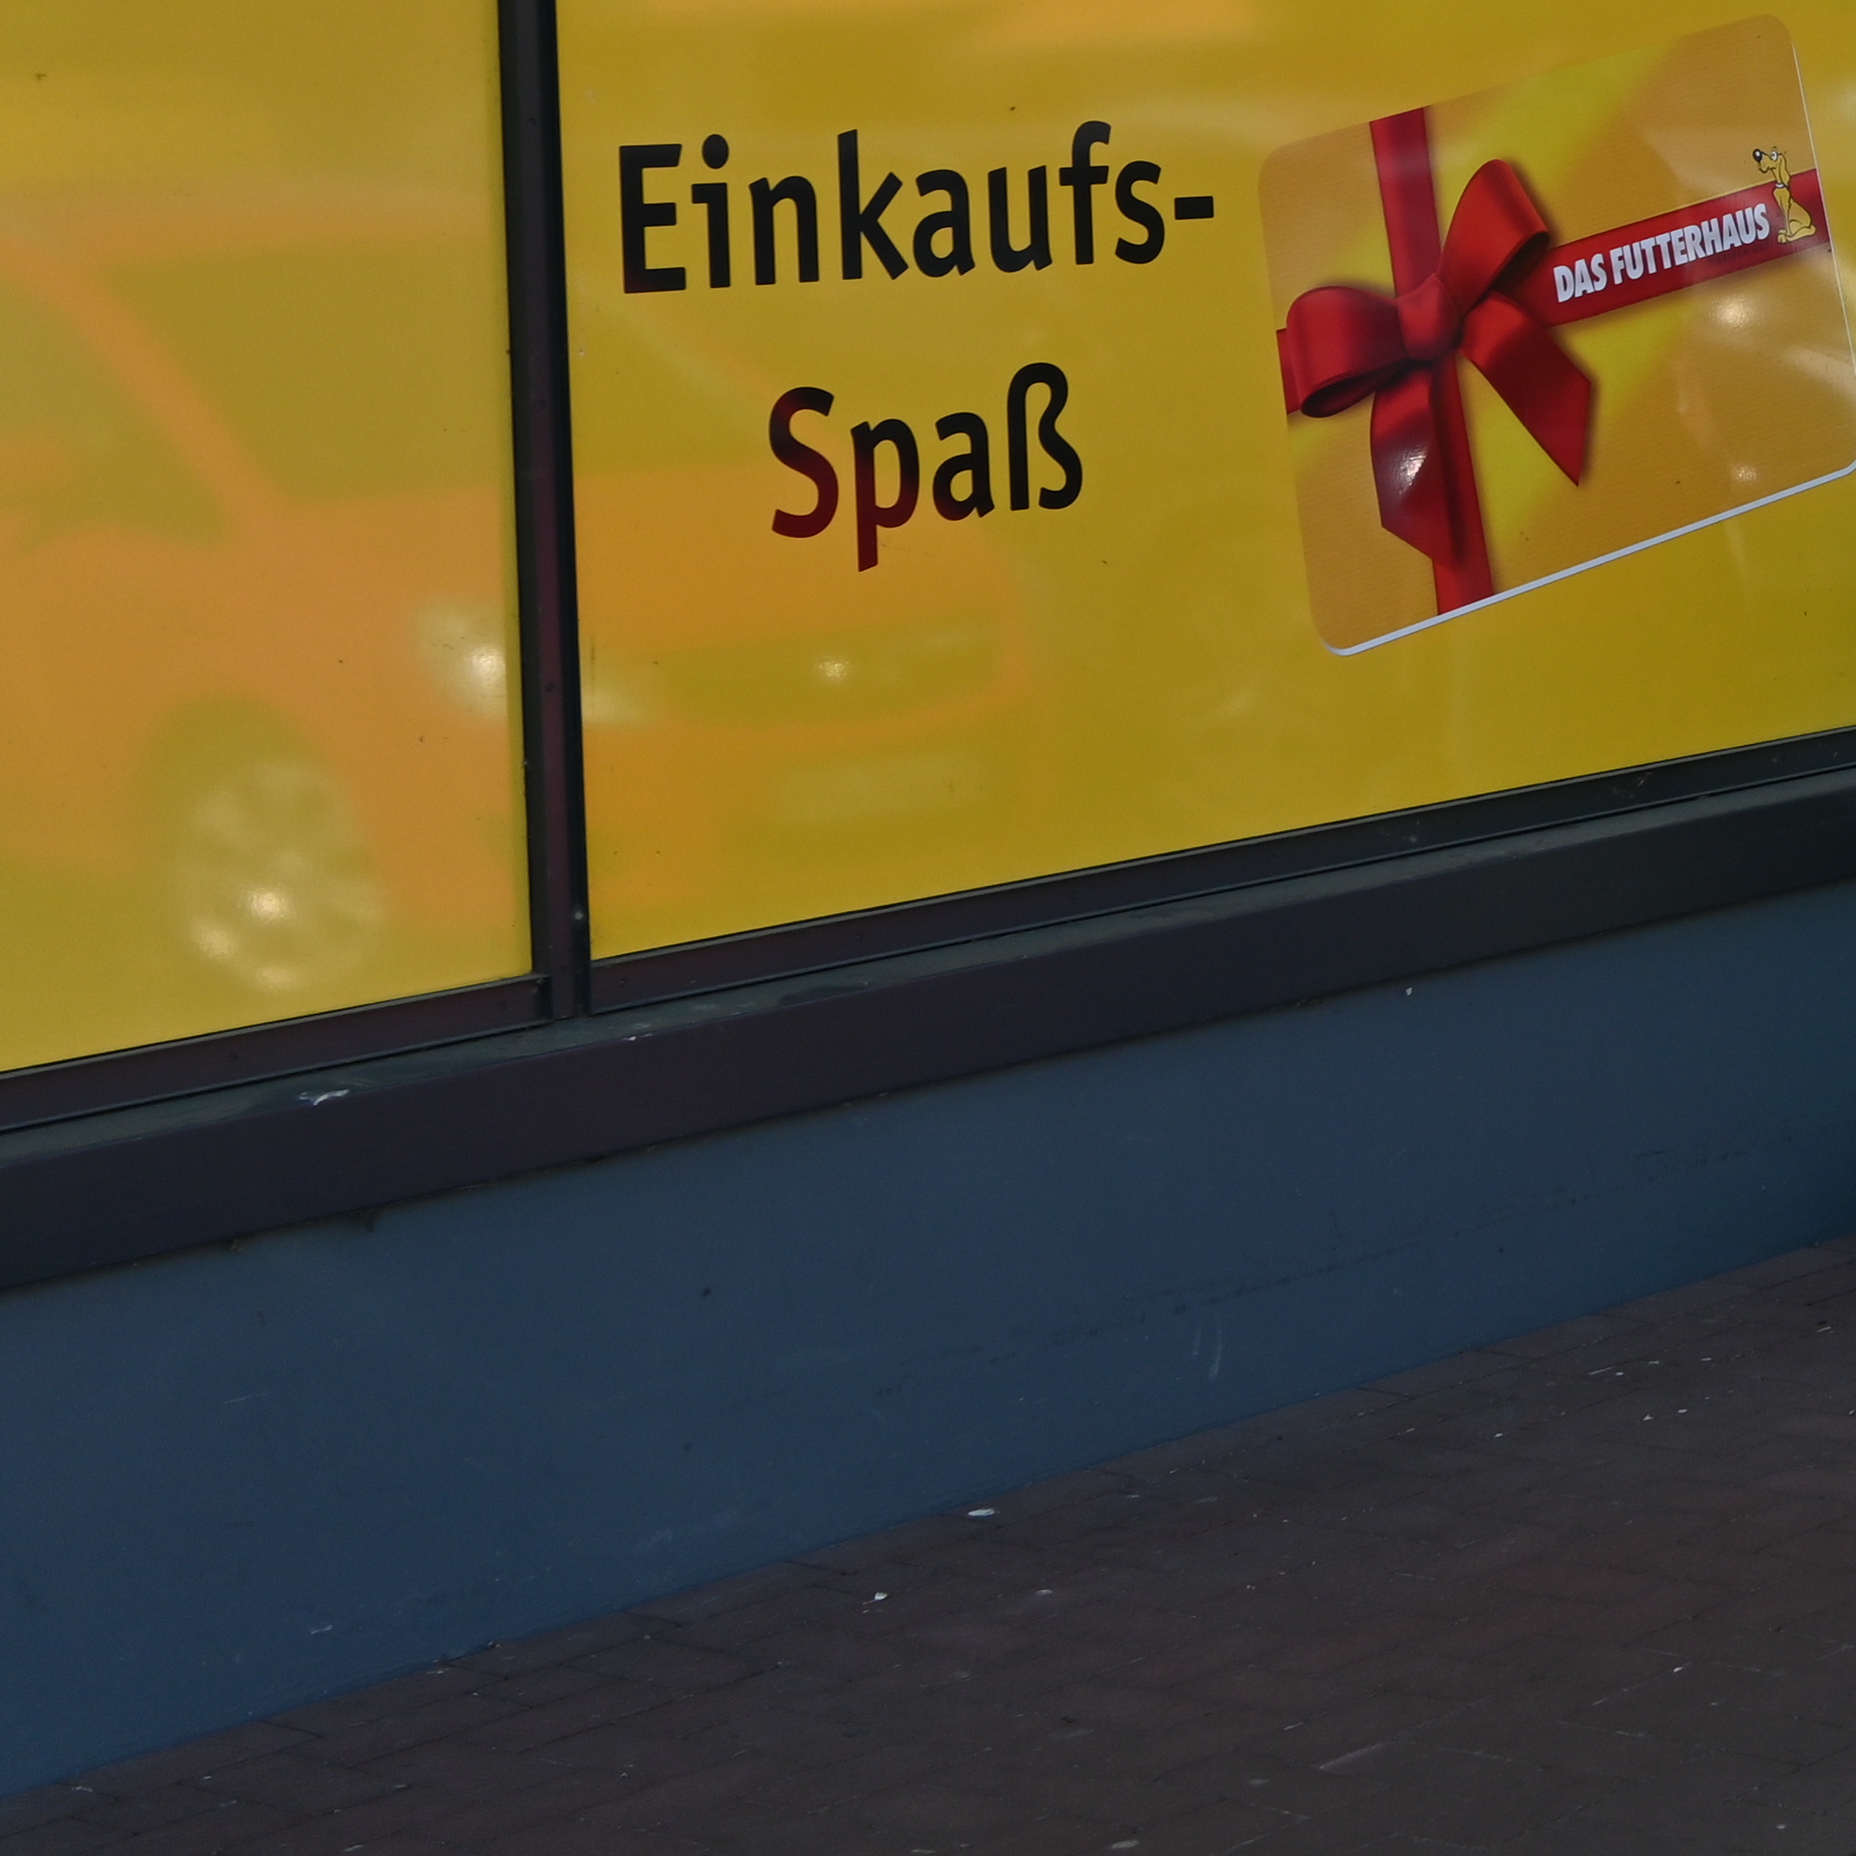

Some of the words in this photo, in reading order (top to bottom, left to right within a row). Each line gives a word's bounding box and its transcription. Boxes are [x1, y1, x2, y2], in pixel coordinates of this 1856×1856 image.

[618, 120, 1215, 294] Einkaufs-
[1553, 253, 1608, 303] DAS
[1610, 203, 1770, 286] FUTTERHAUS
[767, 361, 1084, 572] Spaß
